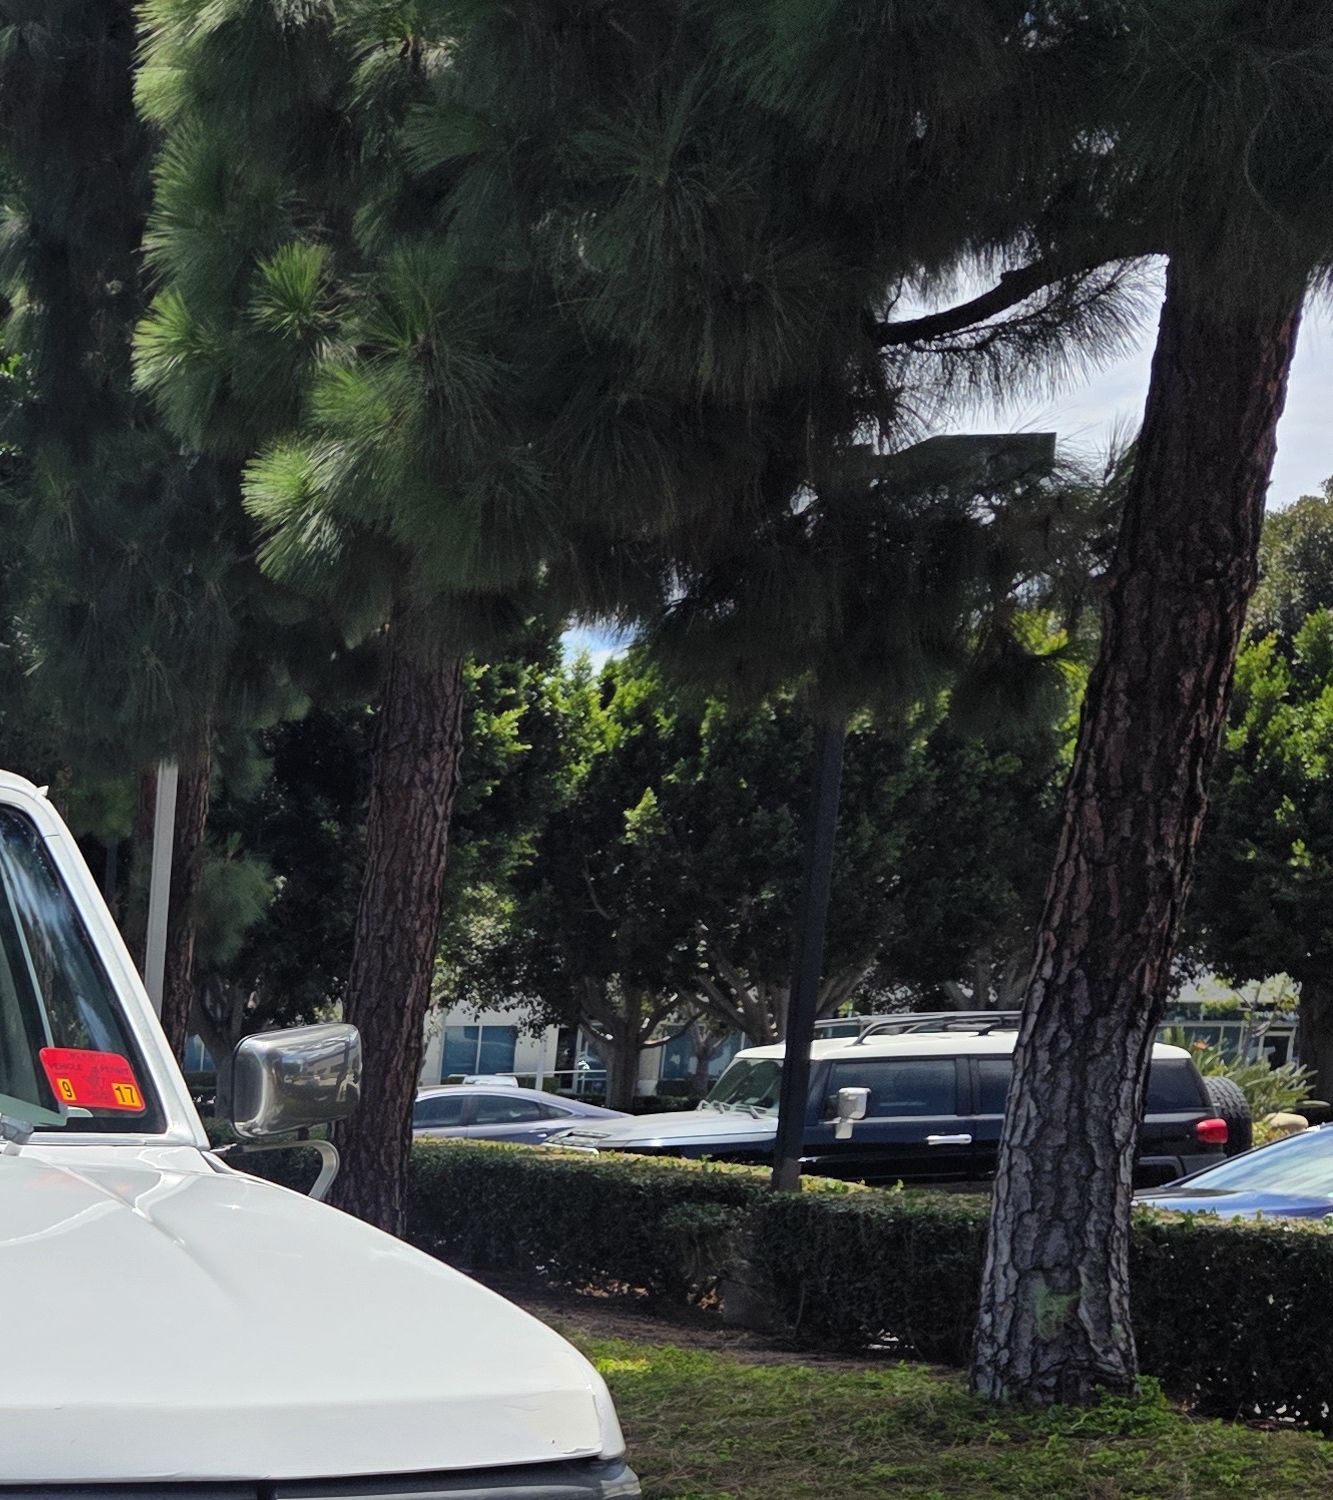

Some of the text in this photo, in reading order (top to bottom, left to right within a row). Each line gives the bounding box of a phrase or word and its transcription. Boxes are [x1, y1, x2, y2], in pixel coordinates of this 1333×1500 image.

[49, 1062, 129, 1075] VEHICLE PERMIT
[62, 1081, 73, 1098] 9
[115, 1086, 135, 1103] 17
